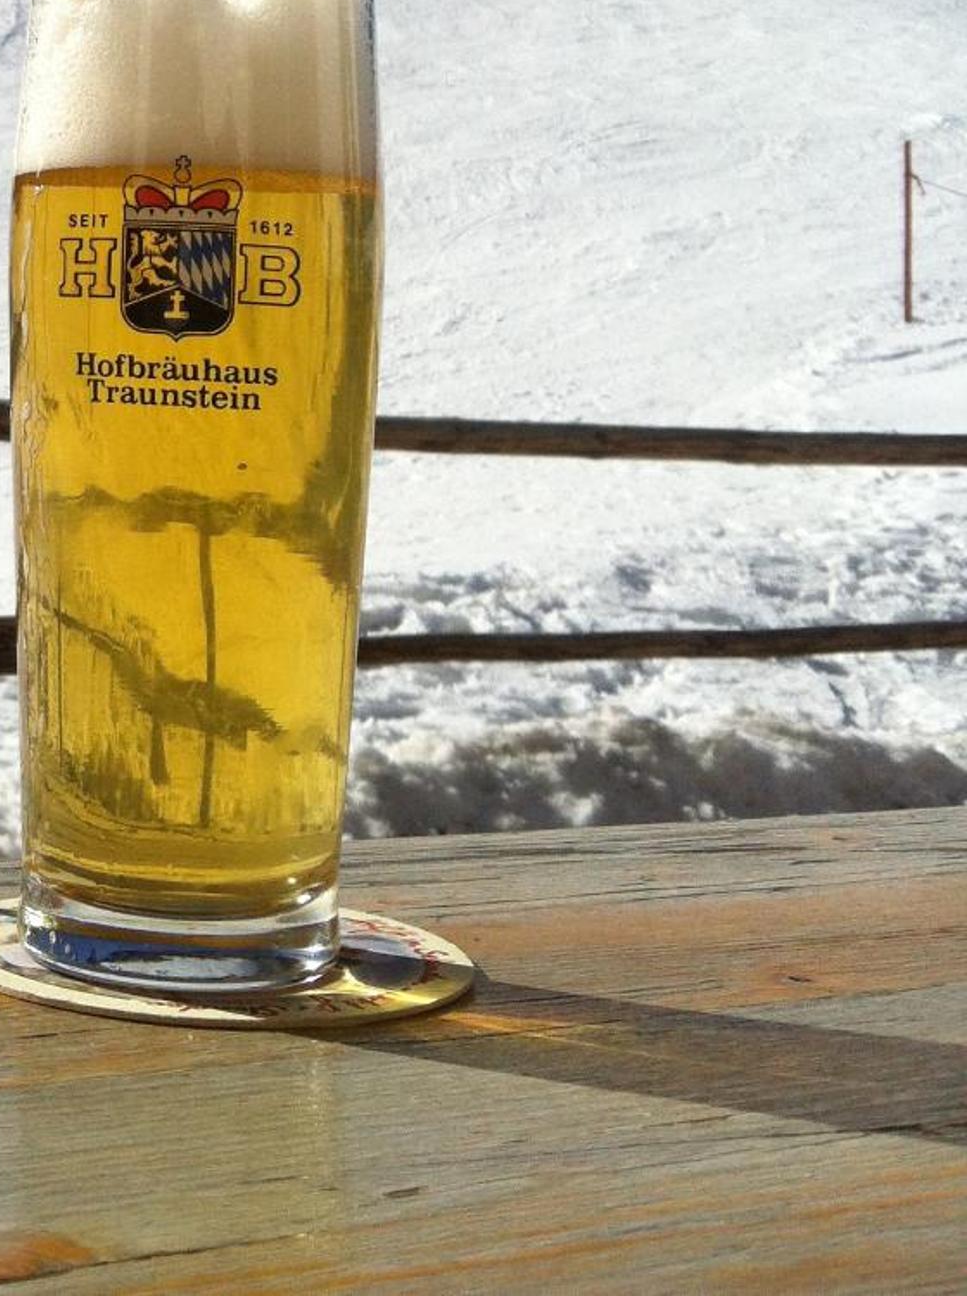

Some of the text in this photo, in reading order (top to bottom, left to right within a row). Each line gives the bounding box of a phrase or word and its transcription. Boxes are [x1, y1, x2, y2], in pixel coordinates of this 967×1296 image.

[68, 213, 294, 236] SEIT 1612
[59, 237, 301, 307] H B
[76, 352, 278, 385] Hofbräuhaus
[87, 378, 262, 410] Traunstein
